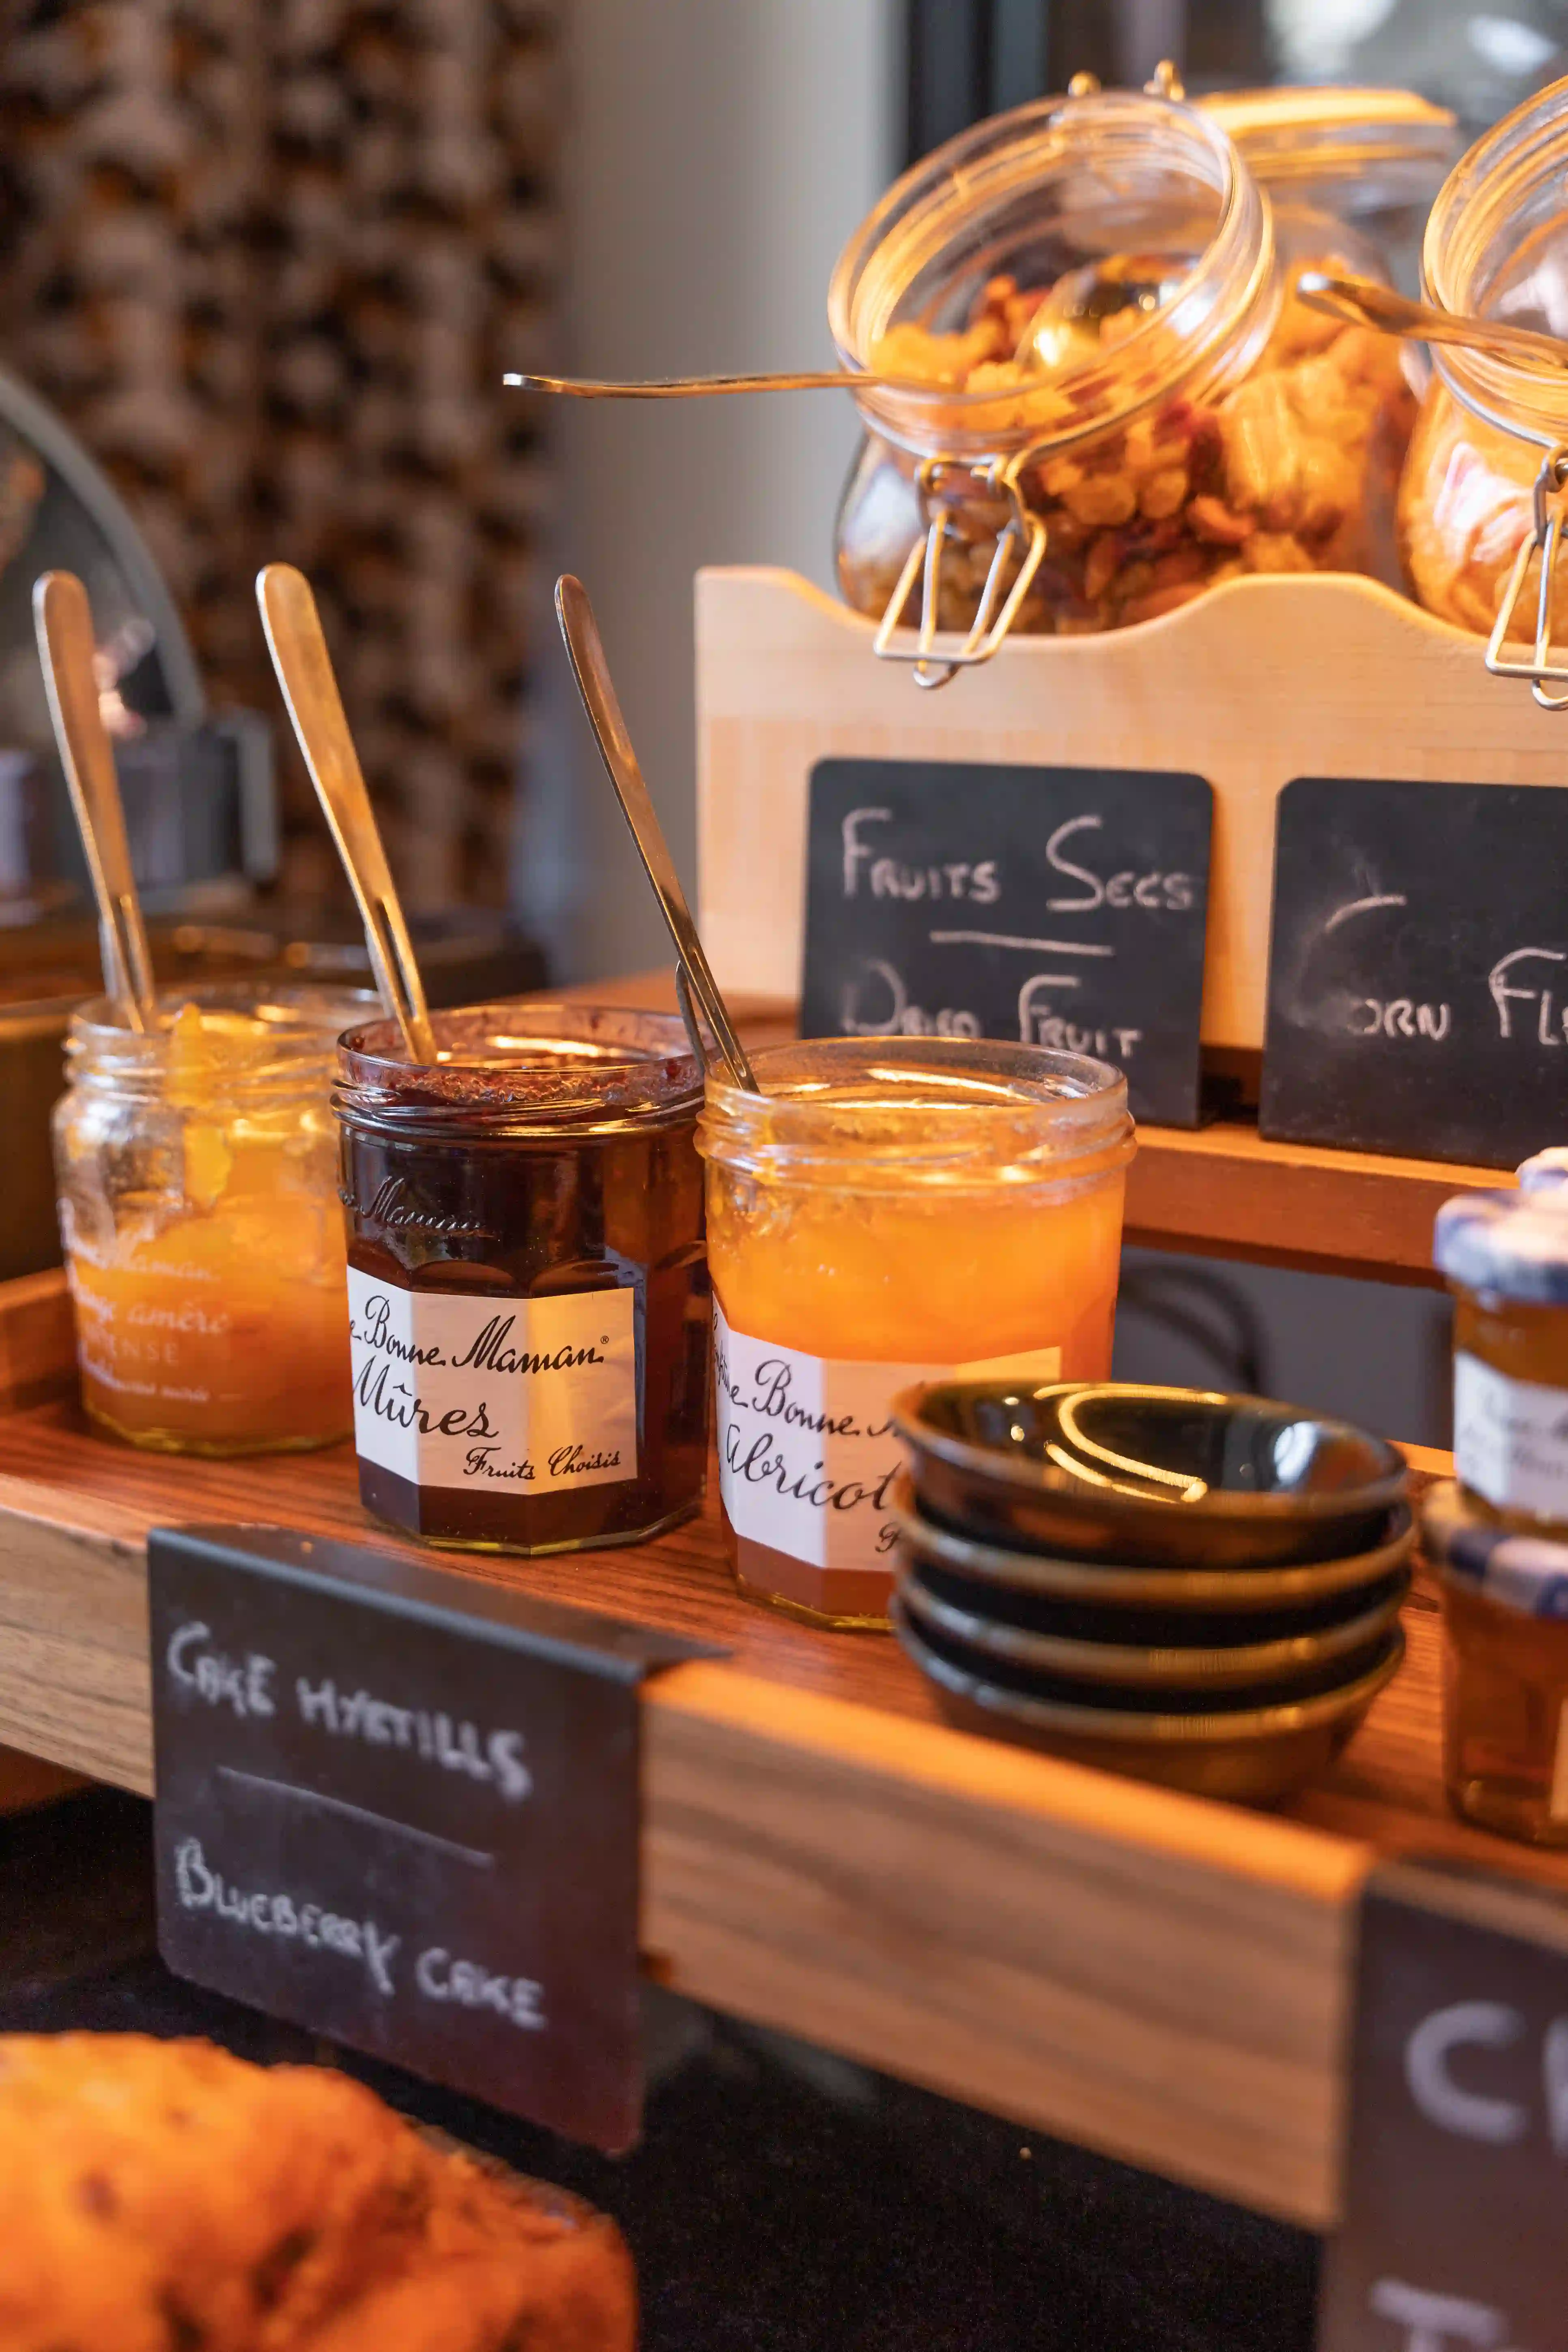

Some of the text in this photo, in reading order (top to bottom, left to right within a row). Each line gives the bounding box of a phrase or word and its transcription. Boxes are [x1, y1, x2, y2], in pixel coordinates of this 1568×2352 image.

[841, 807, 1195, 912] FRUITS SECS
[1488, 946, 1568, 1046] FL
[364, 1295, 446, 1366] Bonne
[353, 1355, 499, 1438] Mûres
[752, 1359, 860, 1436] Bonne
[463, 1444, 621, 1480] Fruits Choisis
